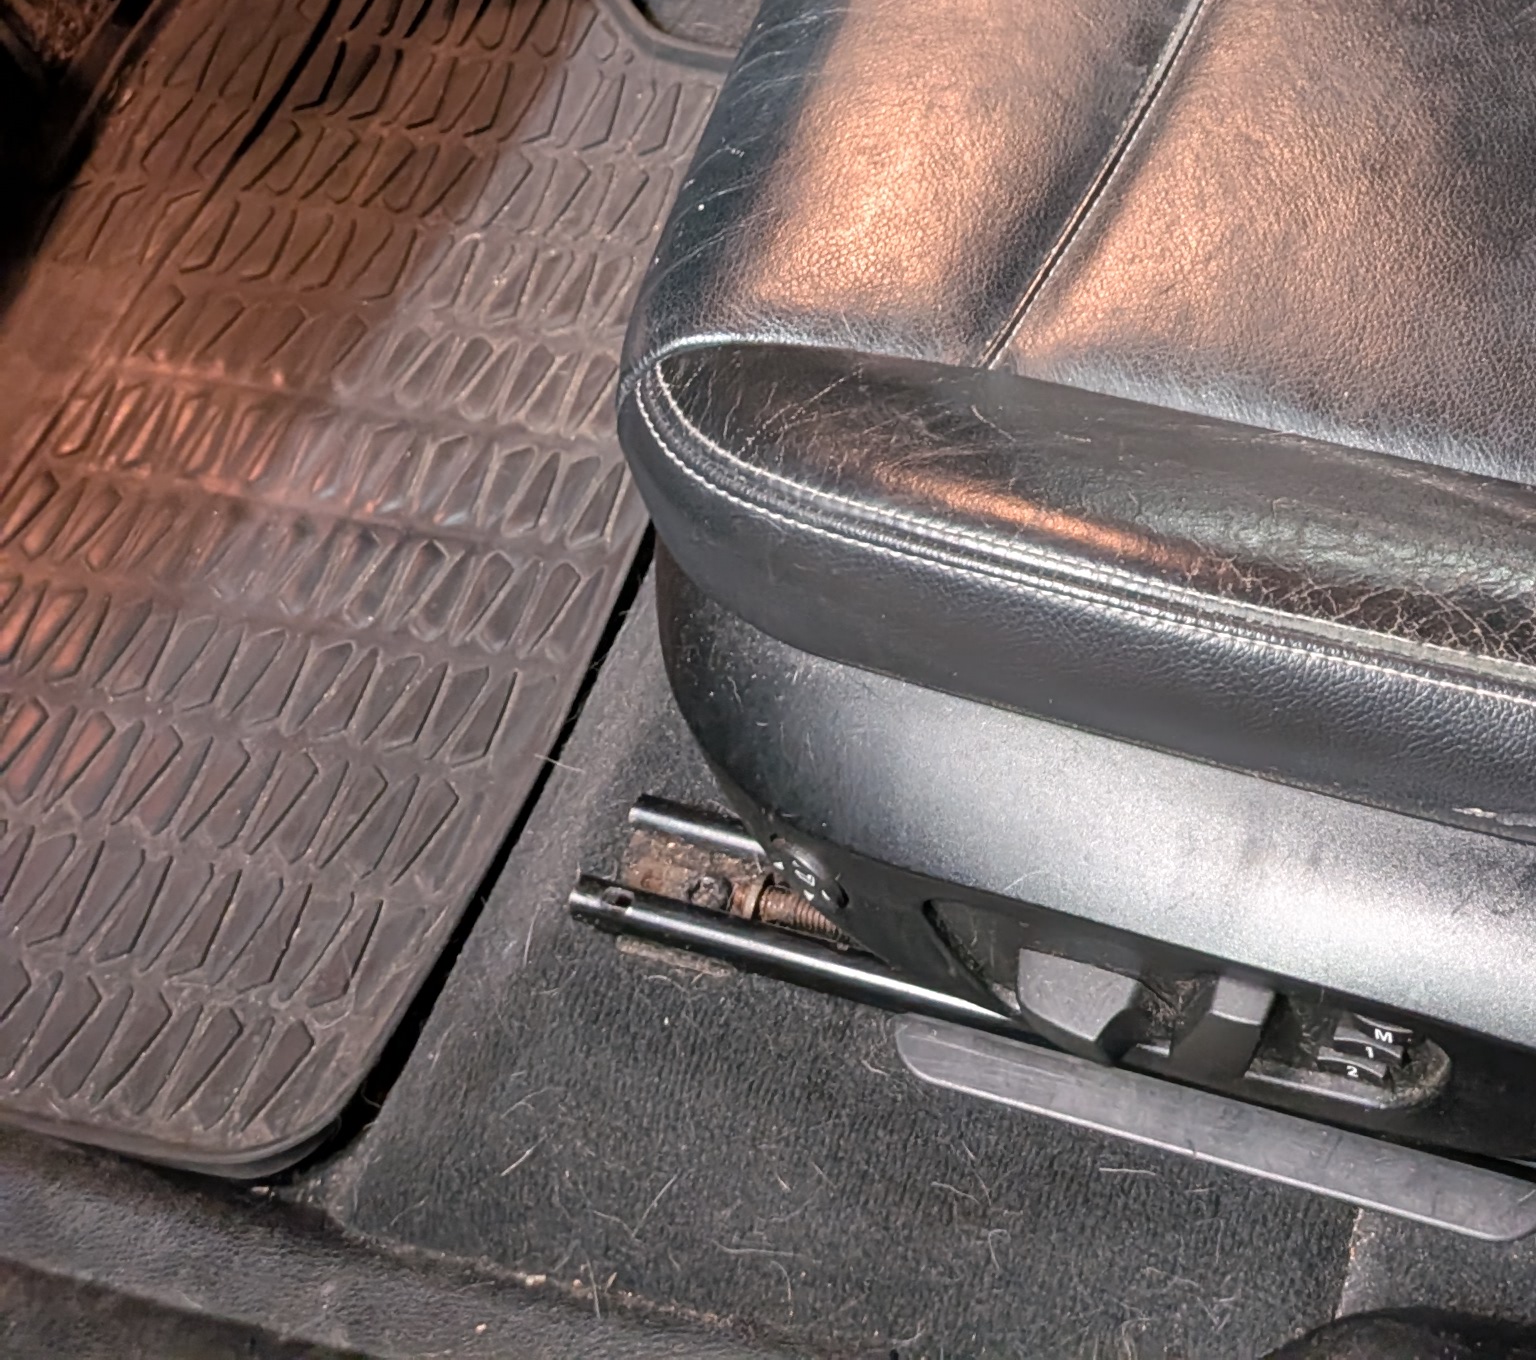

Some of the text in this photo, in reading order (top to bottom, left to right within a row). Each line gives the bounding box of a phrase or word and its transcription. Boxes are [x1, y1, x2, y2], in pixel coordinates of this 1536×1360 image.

[1373, 1028, 1394, 1044] M
[1365, 1045, 1375, 1059] 1
[1345, 1065, 1359, 1078] 2
